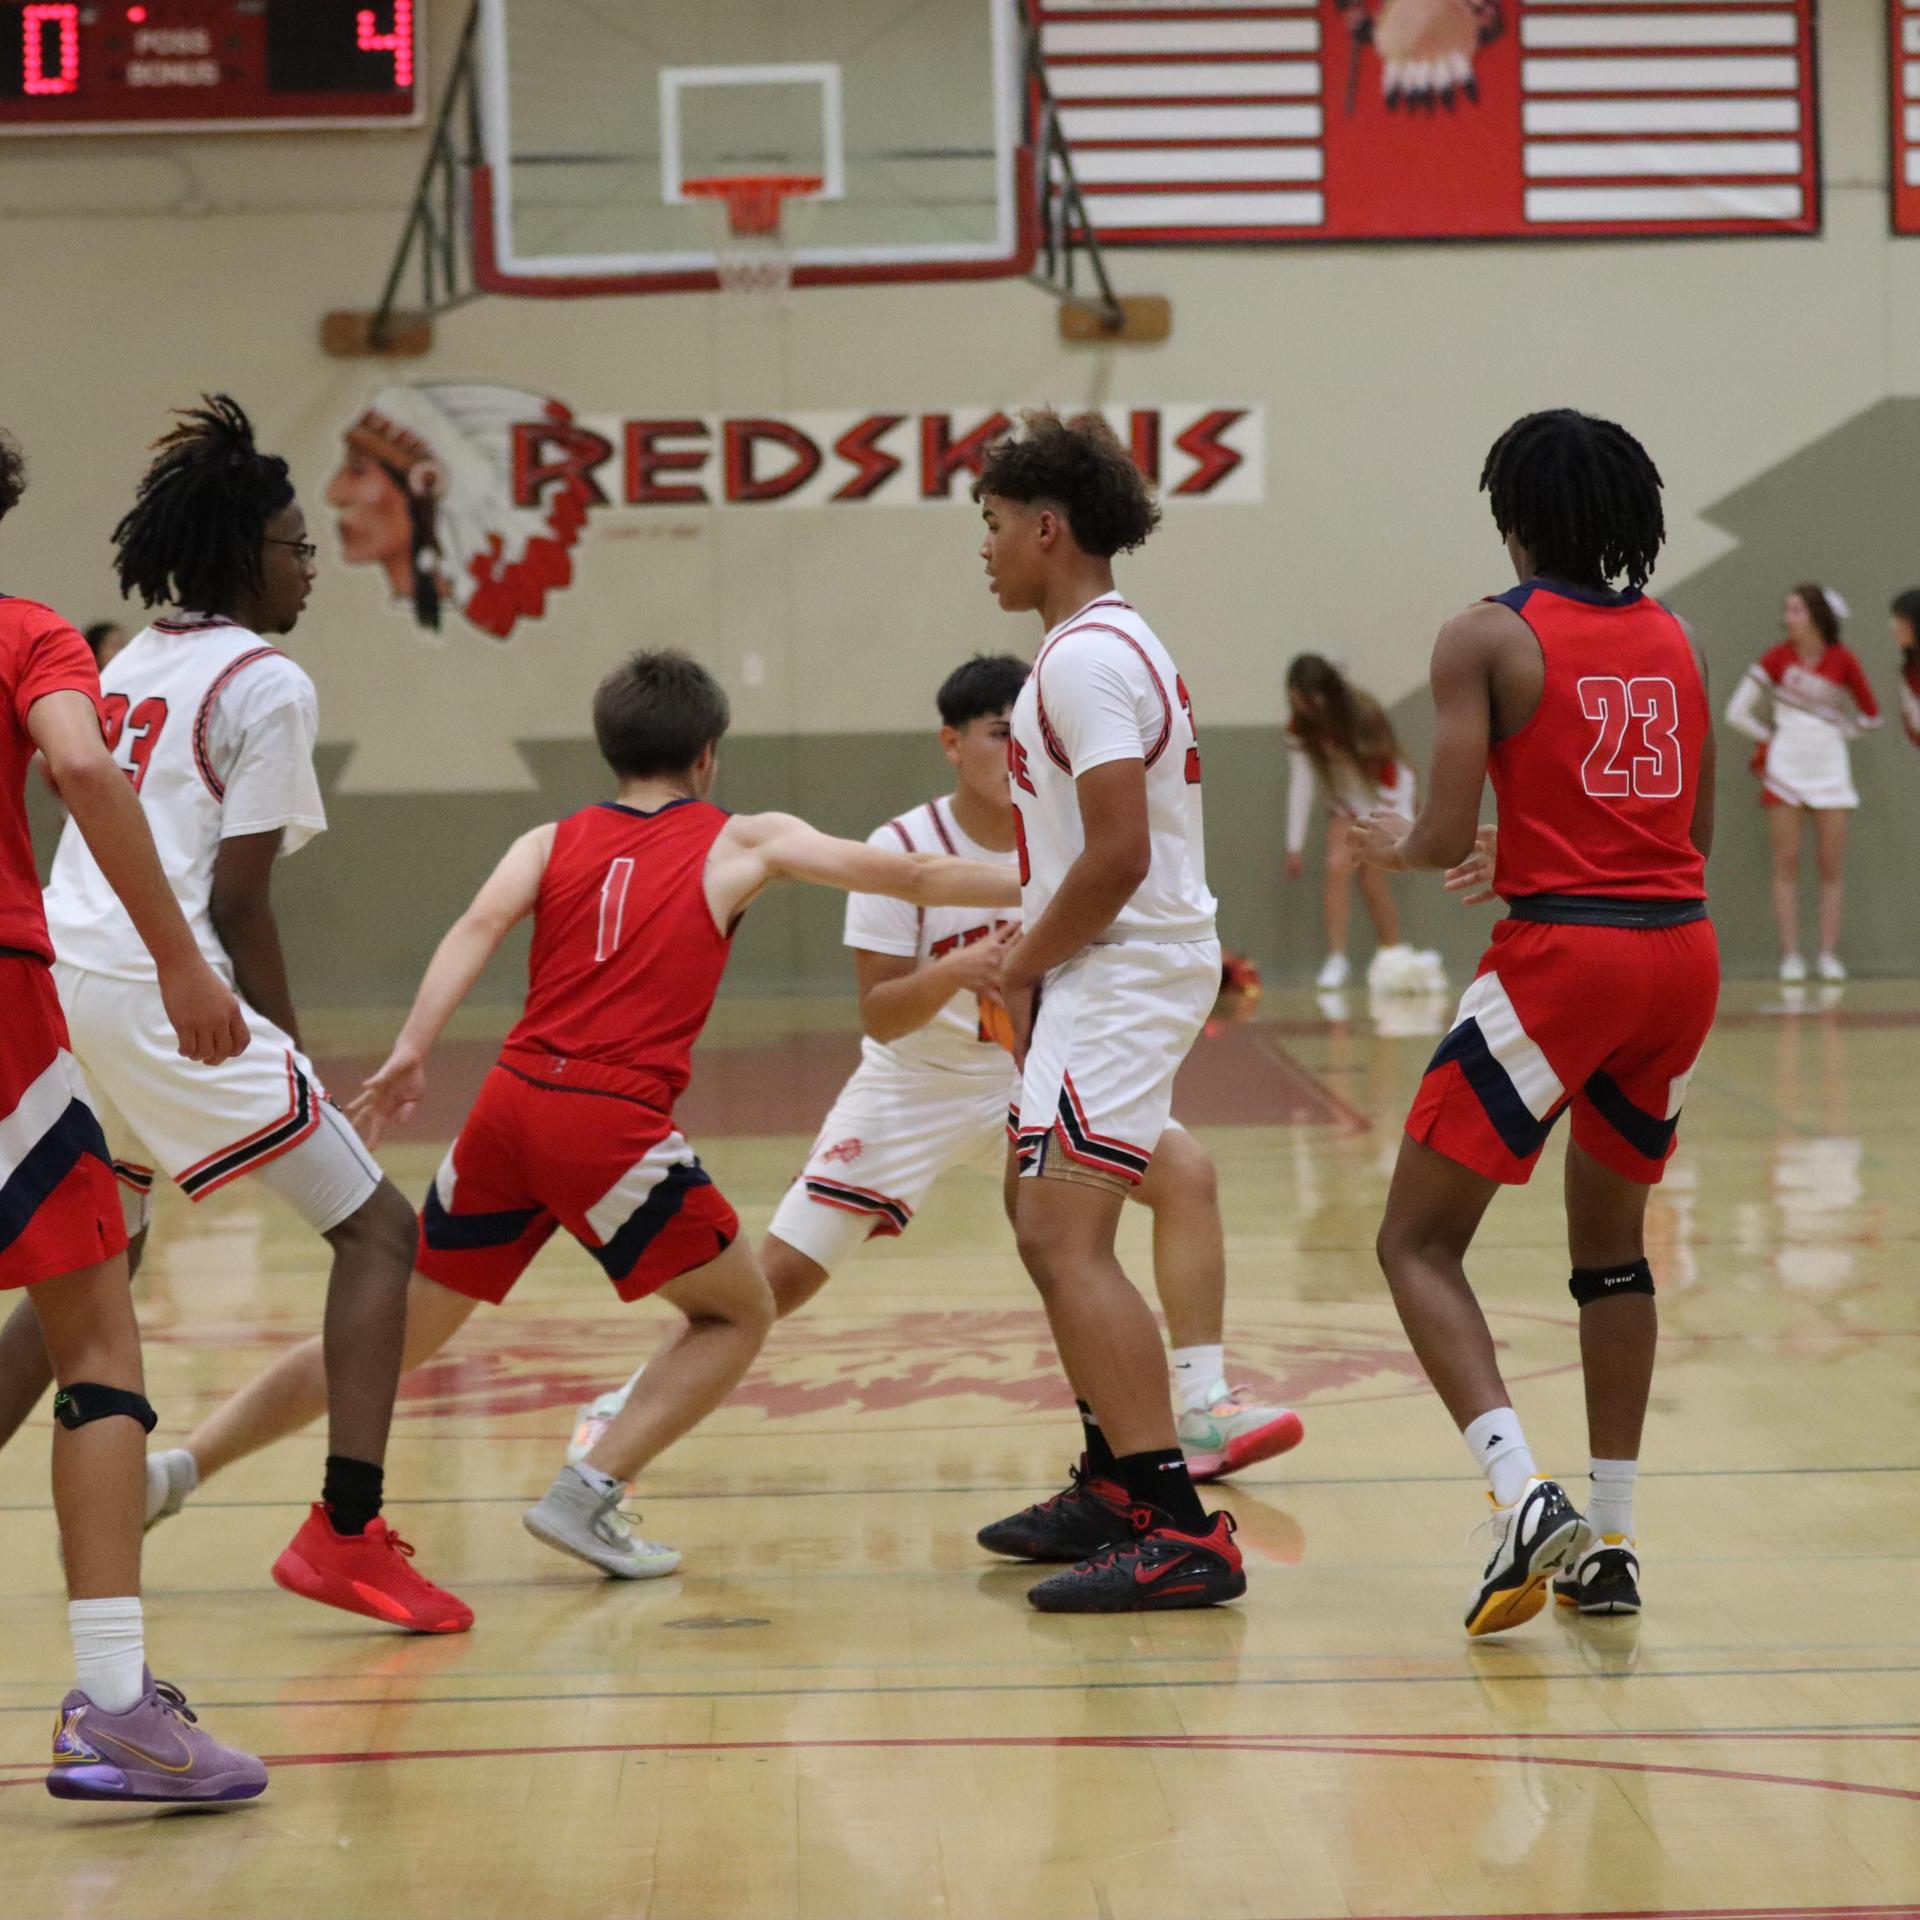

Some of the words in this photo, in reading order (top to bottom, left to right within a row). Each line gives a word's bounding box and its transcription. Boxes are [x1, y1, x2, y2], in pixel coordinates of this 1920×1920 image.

[23, 3, 79, 95] 0
[357, 0, 413, 87] 4
[1577, 676, 1682, 798] 23
[595, 858, 635, 961] 1
